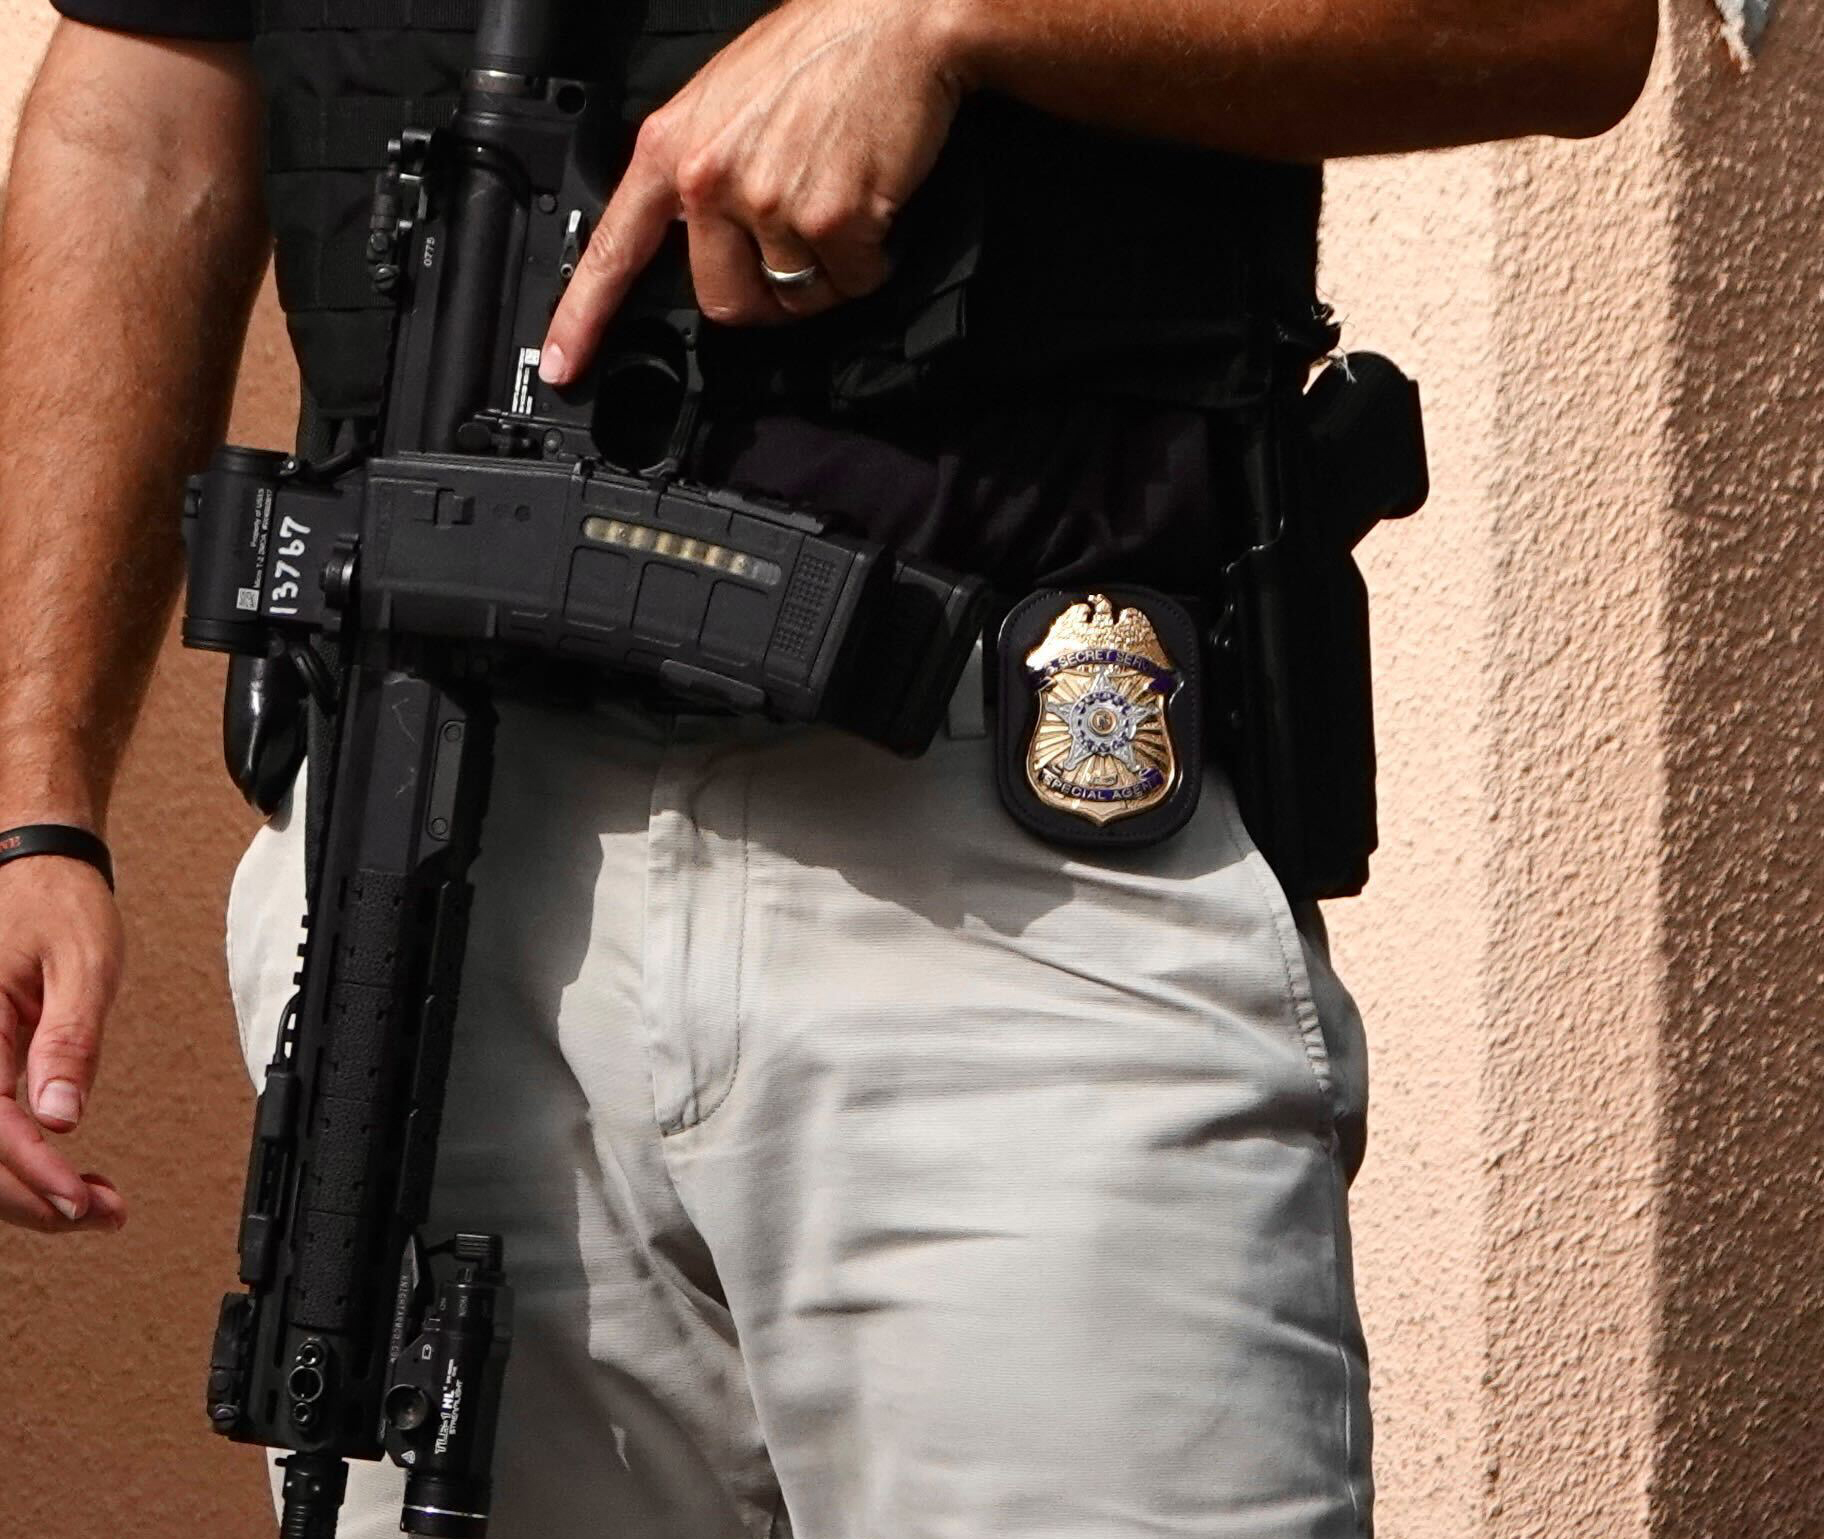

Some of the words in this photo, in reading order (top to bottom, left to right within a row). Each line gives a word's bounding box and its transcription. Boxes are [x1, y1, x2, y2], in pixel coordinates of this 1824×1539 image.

[268, 515, 312, 615] 13767
[1057, 649, 1114, 668] SECRET
[1041, 769, 1108, 800] SPECIAL
